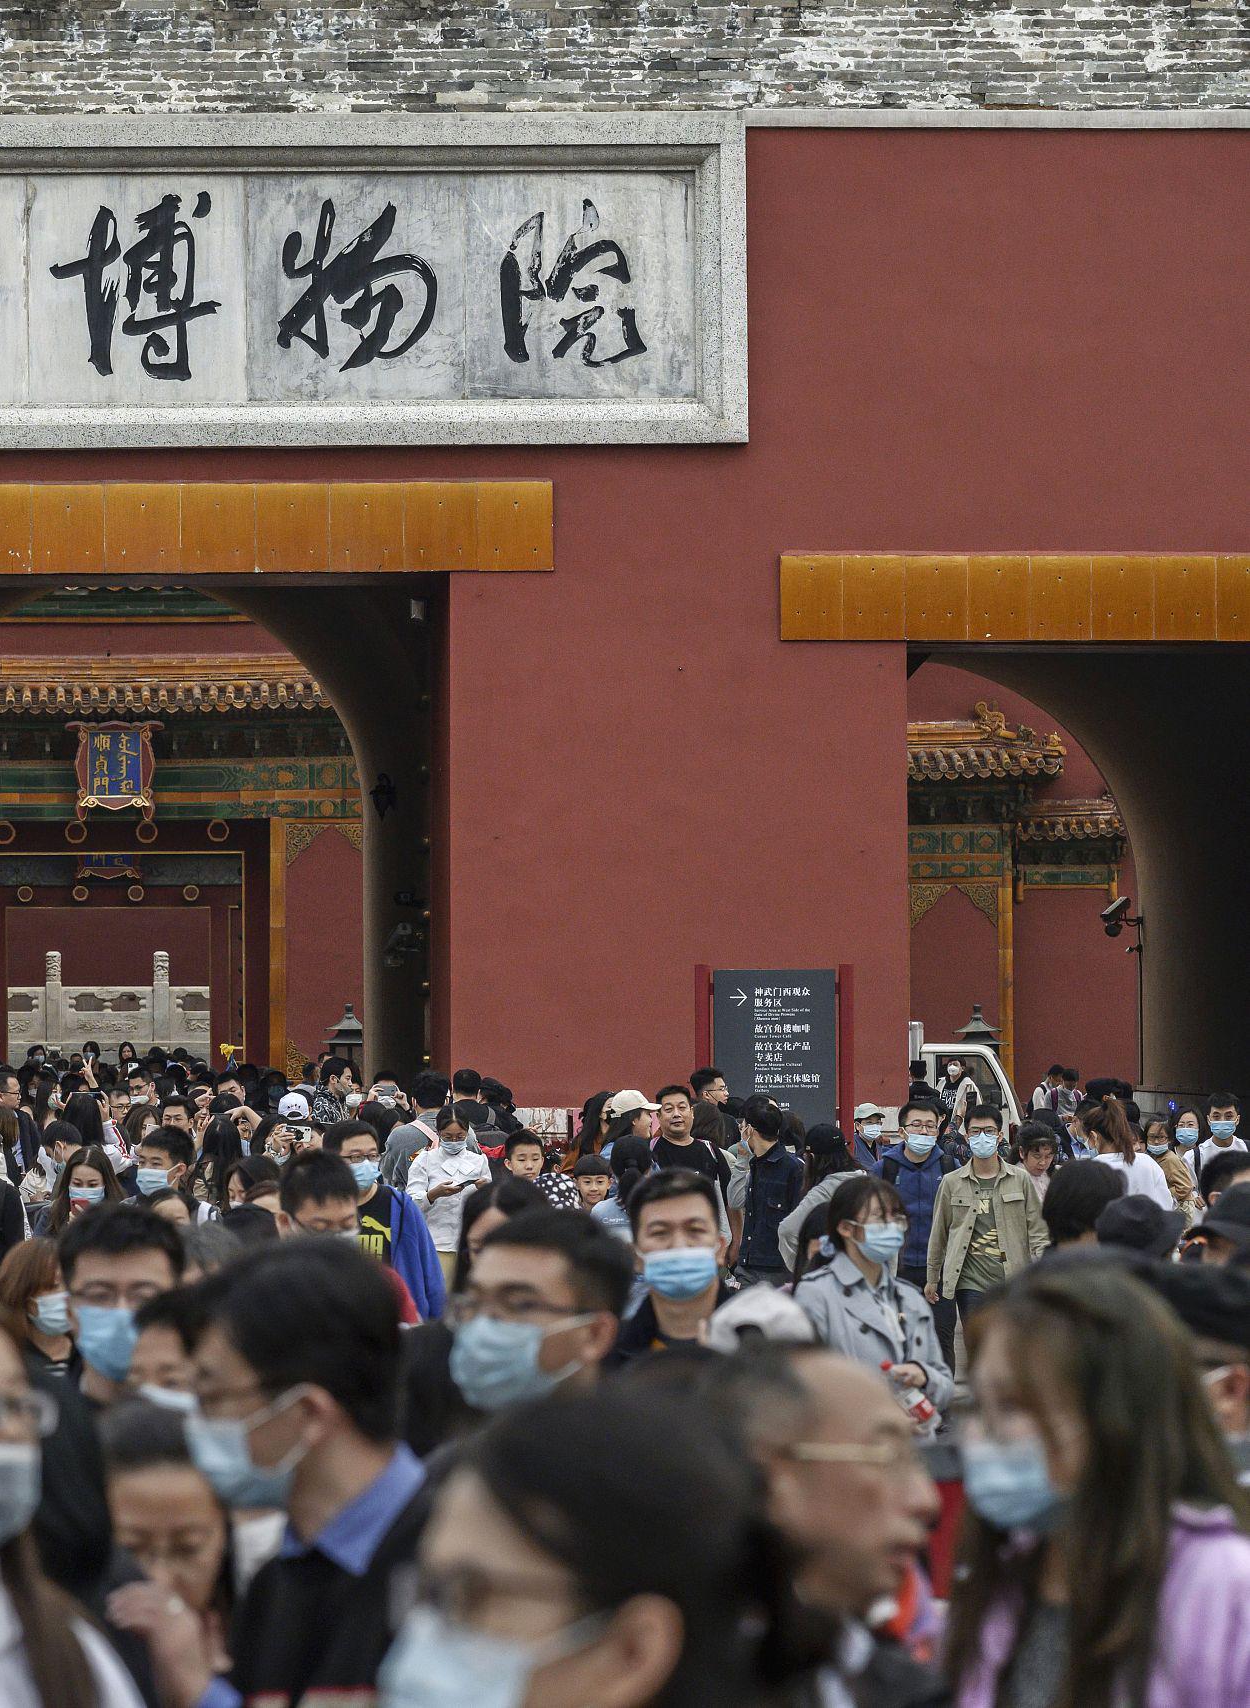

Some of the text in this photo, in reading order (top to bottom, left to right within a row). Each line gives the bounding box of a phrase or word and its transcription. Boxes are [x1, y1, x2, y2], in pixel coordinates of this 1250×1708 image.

[93, 733, 111, 796] 順貞門
[754, 987, 810, 997] 神武门西观众
[754, 998, 782, 1007] 服务区
[755, 1024, 810, 1033] 故宫角楼咖啡
[755, 1042, 810, 1050] 故宫文化产品
[755, 1053, 782, 1061] 专卖店
[755, 1074, 820, 1083] 故宫淘宝体验馆
